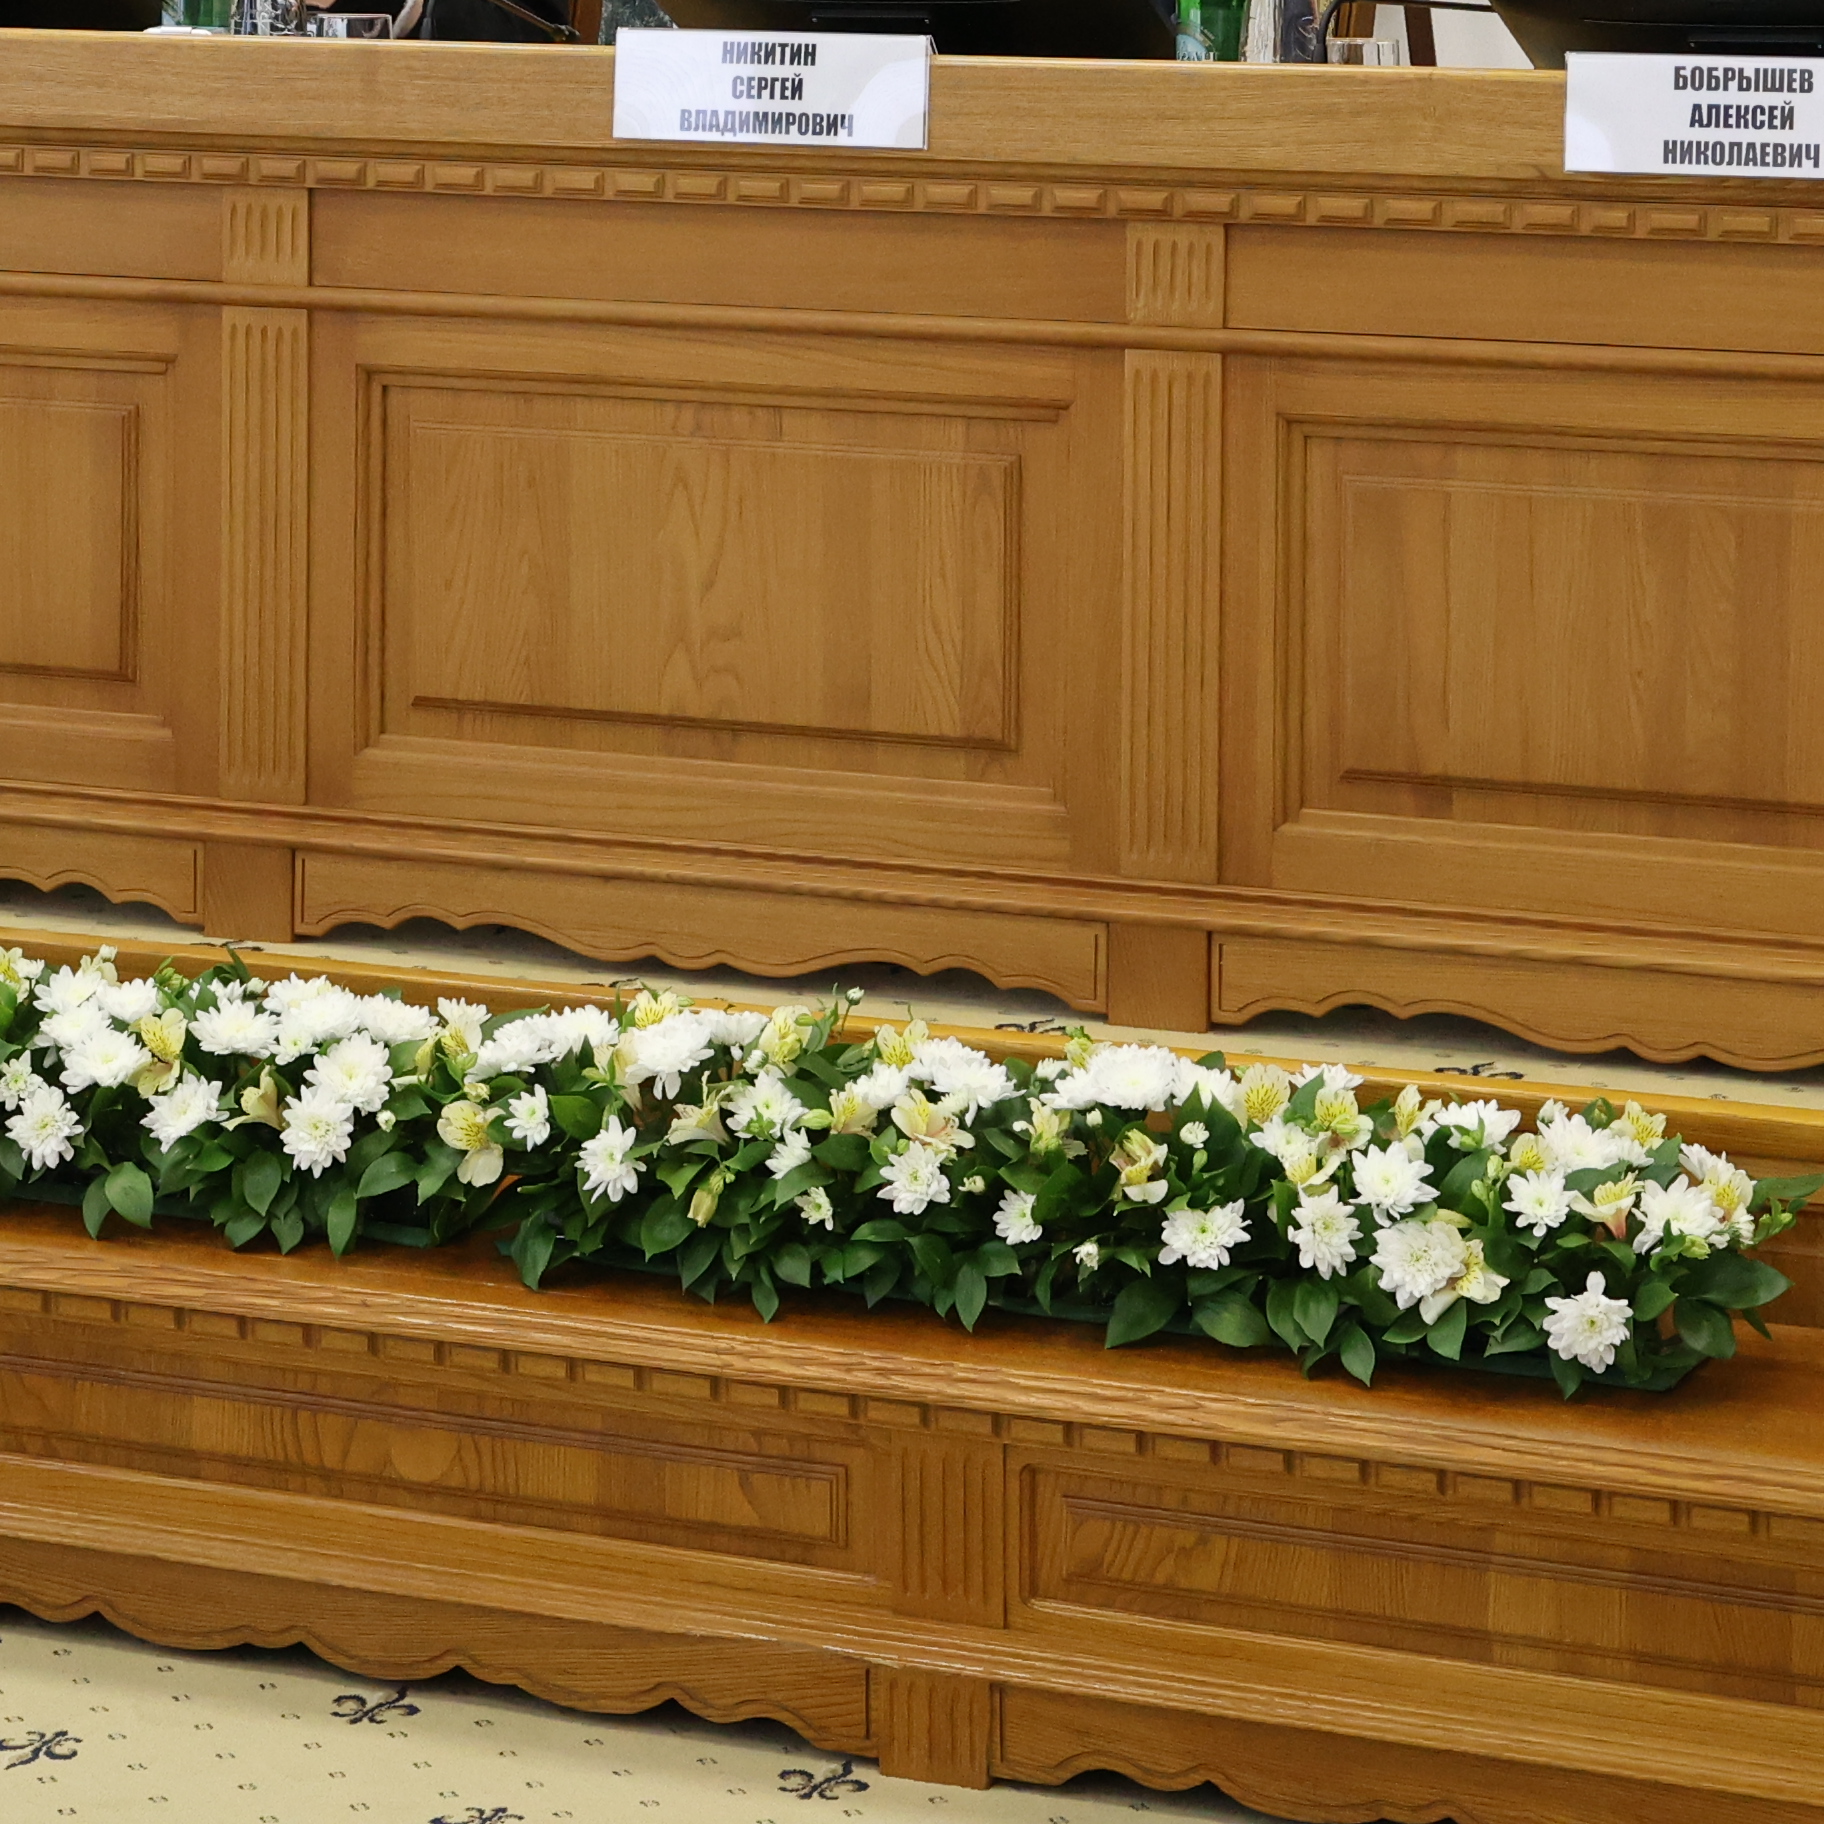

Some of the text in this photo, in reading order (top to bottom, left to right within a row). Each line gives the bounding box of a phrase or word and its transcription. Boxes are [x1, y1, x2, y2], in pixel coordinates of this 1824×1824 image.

[721, 40, 818, 67] НИКИТИН
[731, 72, 804, 101] СЕРГЕЙ
[1673, 65, 1814, 94] БОБРЫШЕВ
[679, 108, 855, 137] ВЛАДИМИРОВИЧ
[1688, 100, 1795, 131] АЛЕКСЕЙ
[1662, 139, 1821, 169] НИКОЛАЕВИЧ
